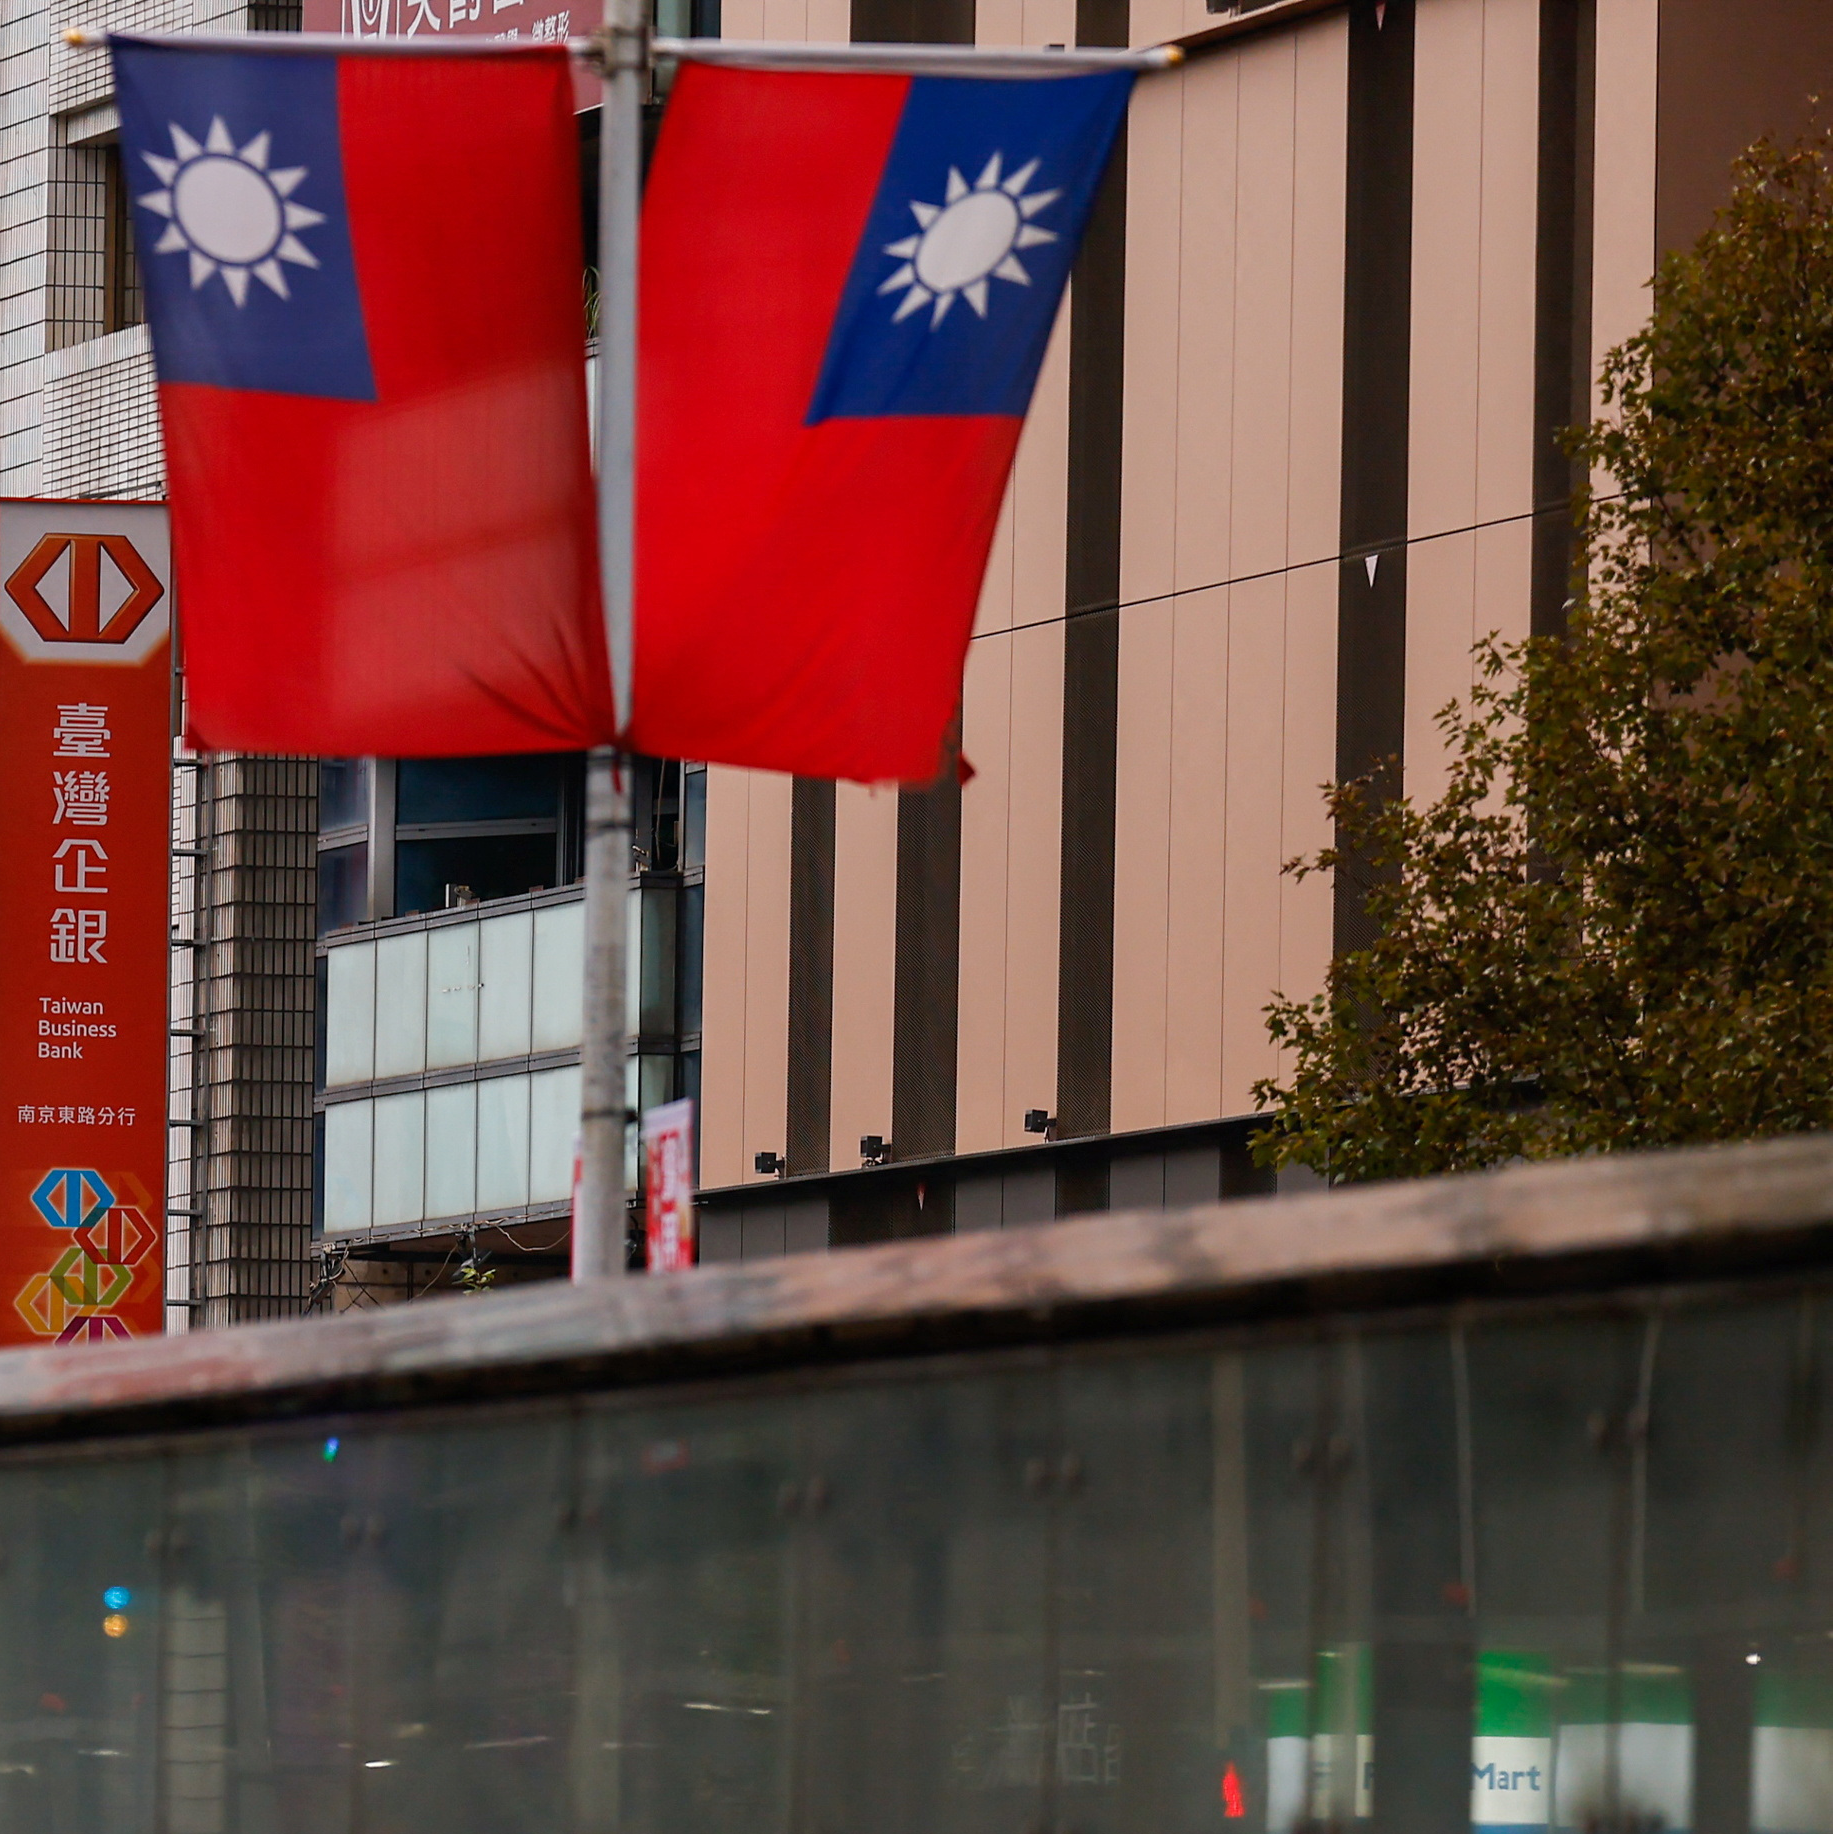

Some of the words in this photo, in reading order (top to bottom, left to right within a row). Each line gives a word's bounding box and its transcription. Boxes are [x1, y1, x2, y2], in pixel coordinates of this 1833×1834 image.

[50, 702, 111, 964] 臺灣企銀
[39, 997, 104, 1015] Taiwan
[38, 1019, 117, 1038] Business
[38, 1042, 83, 1059] Bank
[17, 1104, 136, 1127] 南京東路分行
